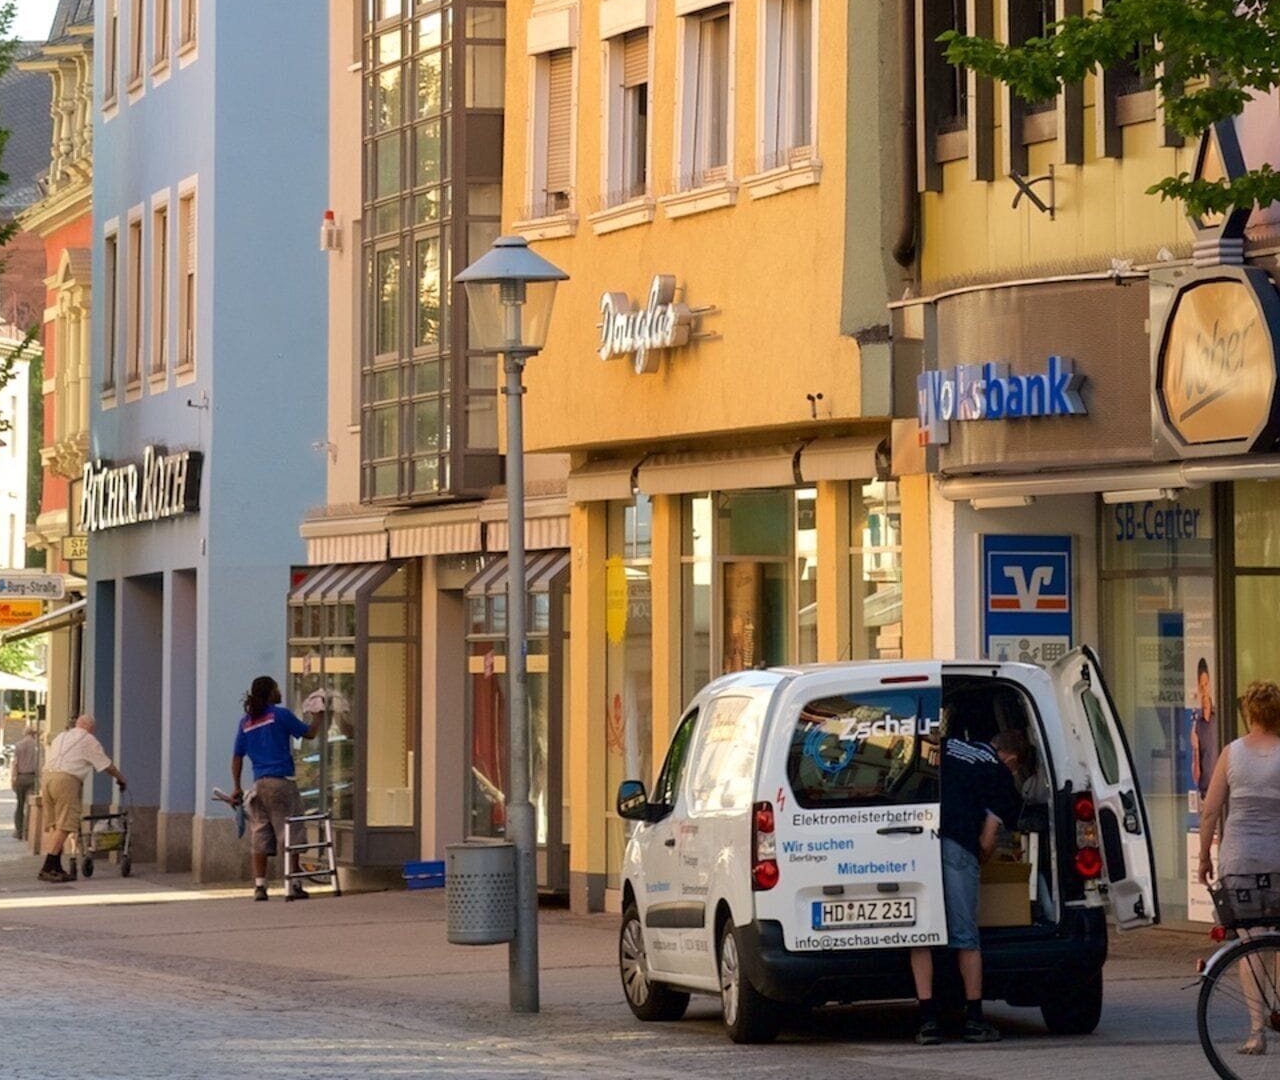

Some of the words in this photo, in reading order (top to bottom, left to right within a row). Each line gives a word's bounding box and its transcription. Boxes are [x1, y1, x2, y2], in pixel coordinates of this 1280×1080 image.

[926, 355, 1086, 420] Volksbank
[1114, 500, 1201, 542] SB-Center
[792, 808, 934, 826] Elektromeisterbetrieb
[782, 841, 804, 853] Wir
[807, 838, 854, 851] suchen
[837, 861, 907, 875] Mitarbeiter
[823, 903, 845, 923] HD
[856, 902, 878, 922] AZ
[882, 901, 913, 920] 231
[795, 932, 940, 951] info@zschau-edv.com
